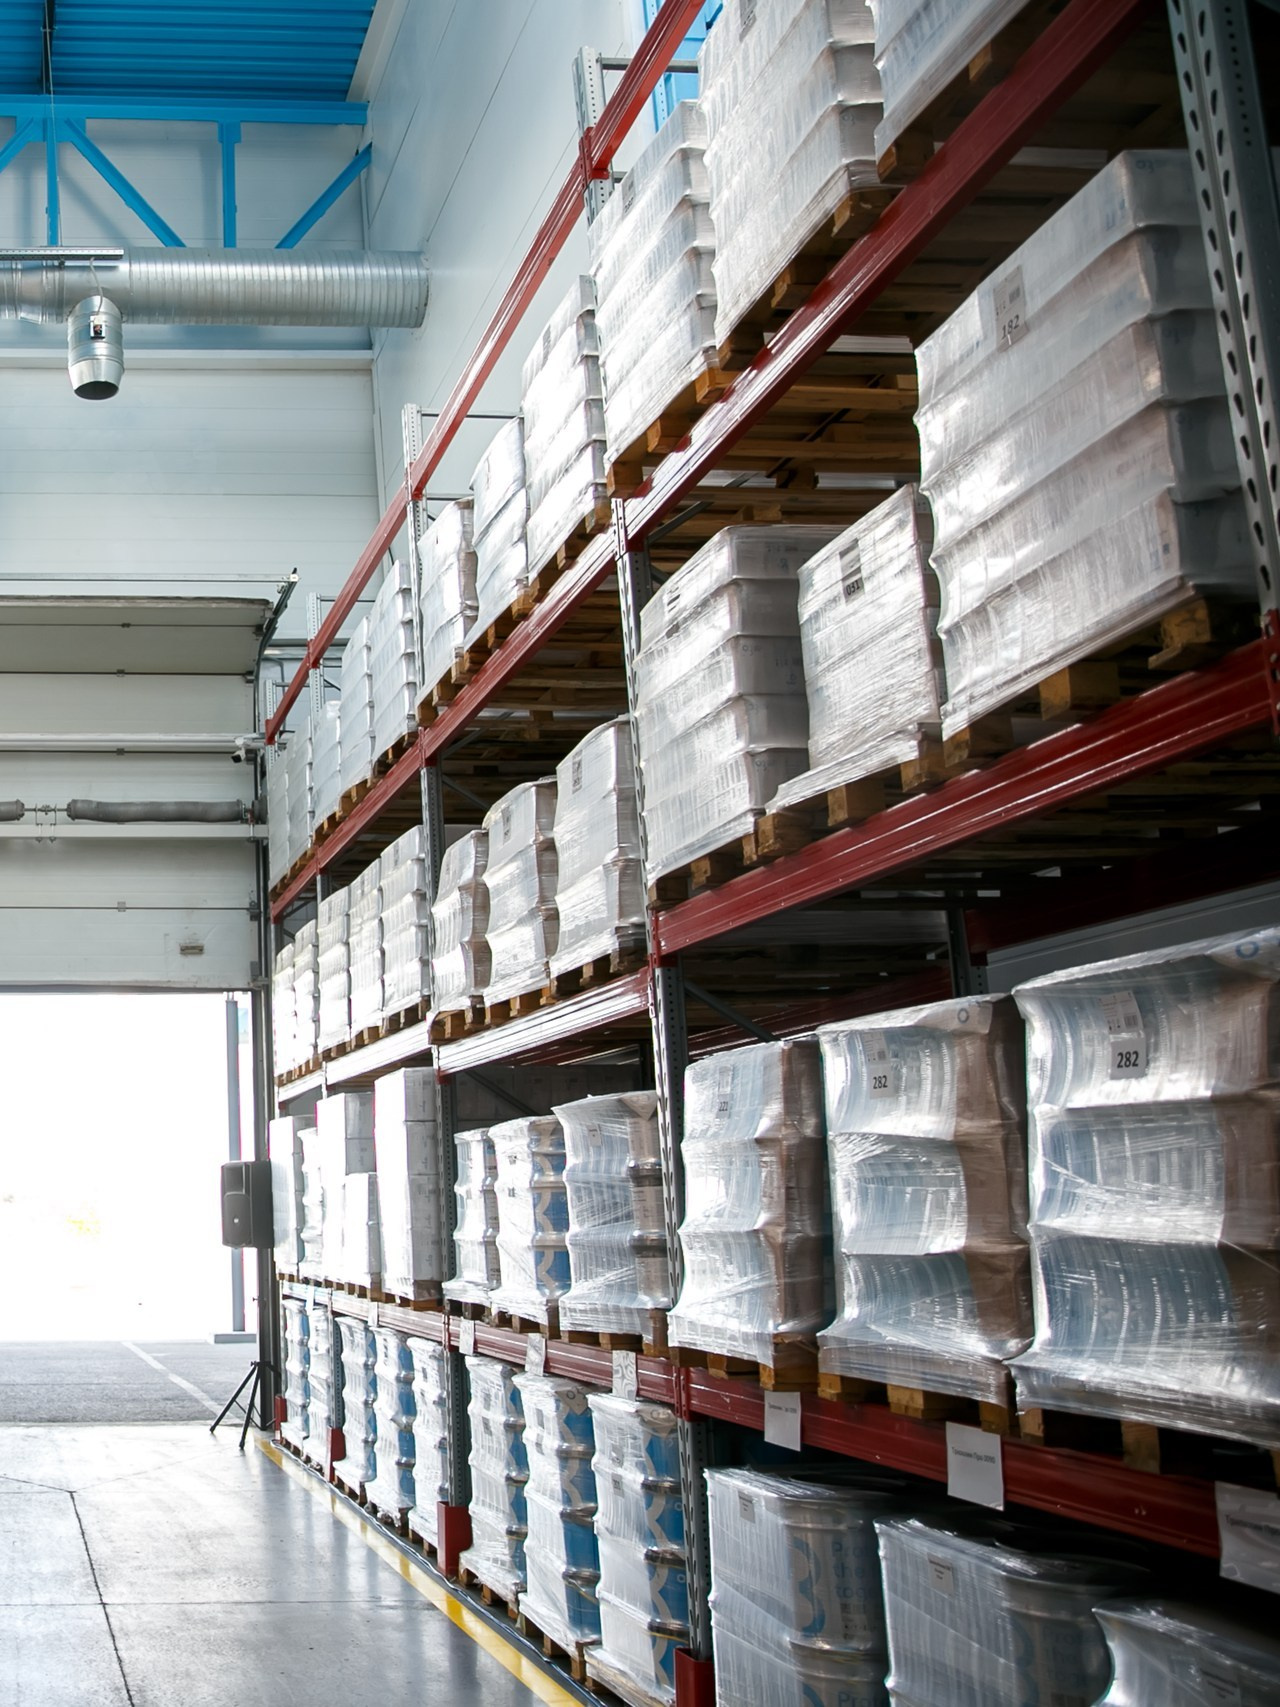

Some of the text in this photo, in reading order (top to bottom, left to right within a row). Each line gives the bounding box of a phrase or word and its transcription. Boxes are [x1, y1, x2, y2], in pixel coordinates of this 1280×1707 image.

[1002, 314, 1019, 339] 182
[1117, 1050, 1139, 1069] 282
[873, 1074, 888, 1089] 282
